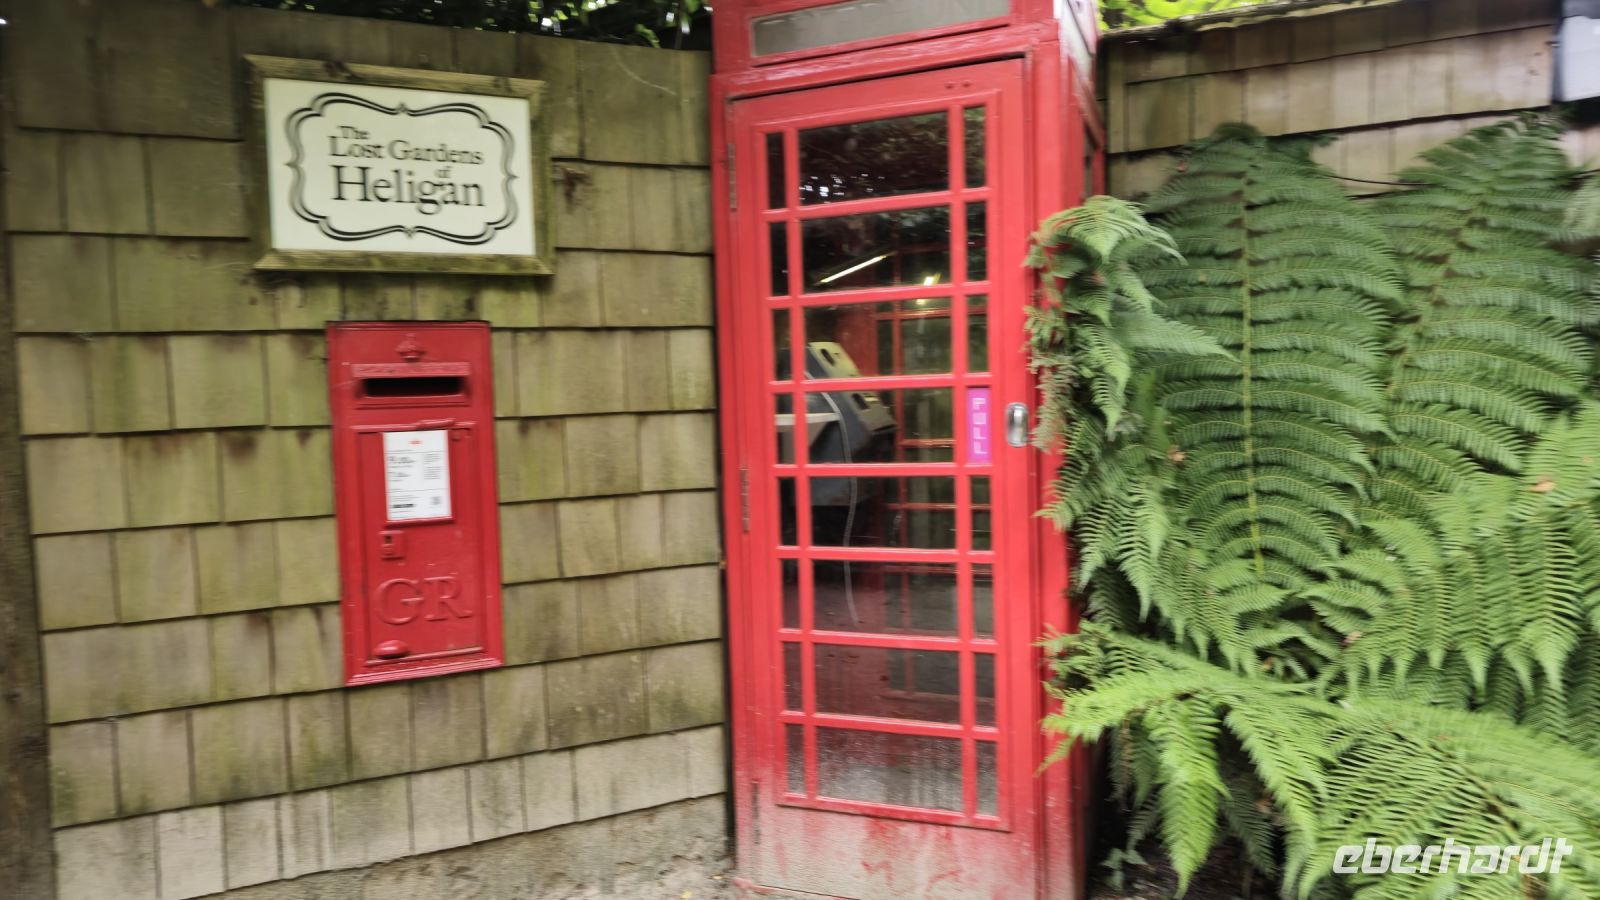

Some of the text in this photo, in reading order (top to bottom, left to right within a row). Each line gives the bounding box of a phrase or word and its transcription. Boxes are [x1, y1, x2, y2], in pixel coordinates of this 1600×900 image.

[330, 136, 483, 163] Lost Gardens
[338, 125, 369, 140] The
[331, 165, 485, 214] Heligan
[435, 166, 453, 179] of
[973, 397, 987, 454] PULL
[375, 576, 472, 625] GR
